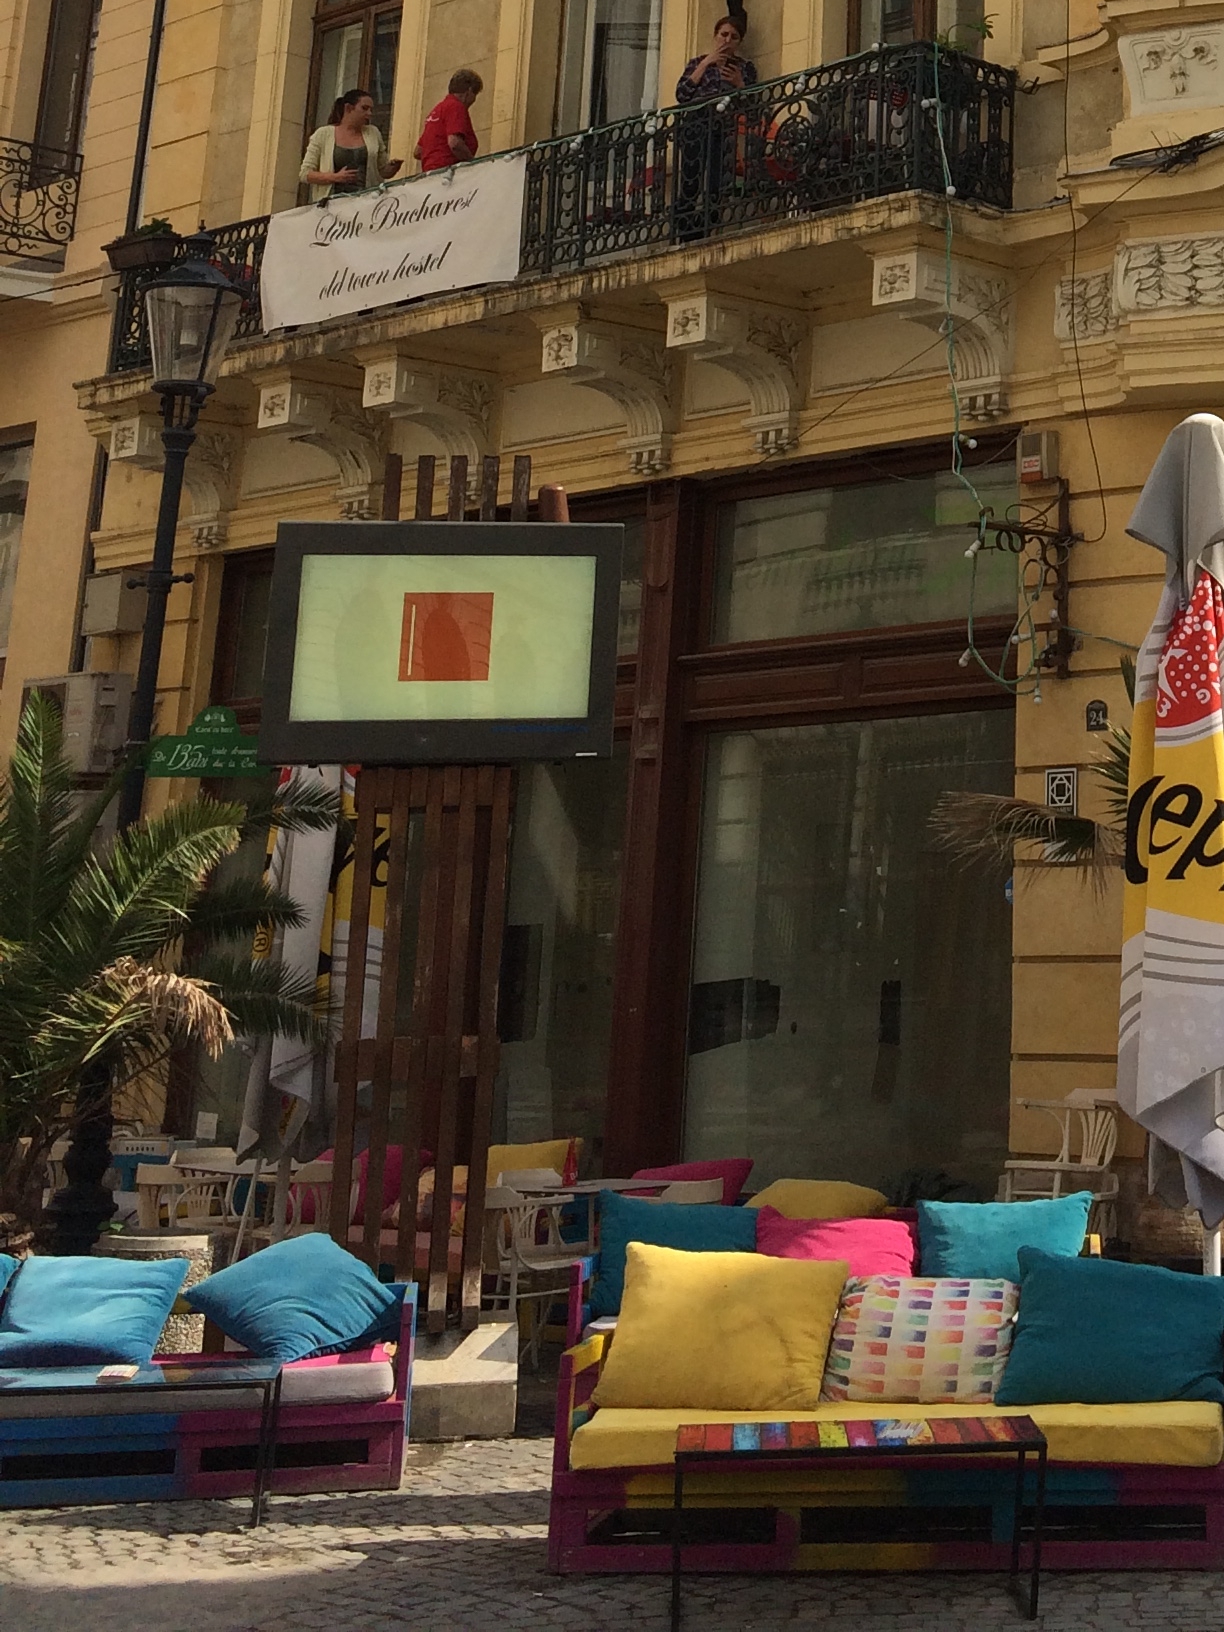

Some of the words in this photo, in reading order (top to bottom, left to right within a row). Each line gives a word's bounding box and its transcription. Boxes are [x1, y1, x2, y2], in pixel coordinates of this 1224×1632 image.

[309, 210, 363, 248] Little
[369, 188, 479, 235] Bucharest
[319, 265, 346, 300] old
[347, 268, 390, 293] town
[392, 241, 452, 282] hostel
[1089, 710, 1104, 726] 24
